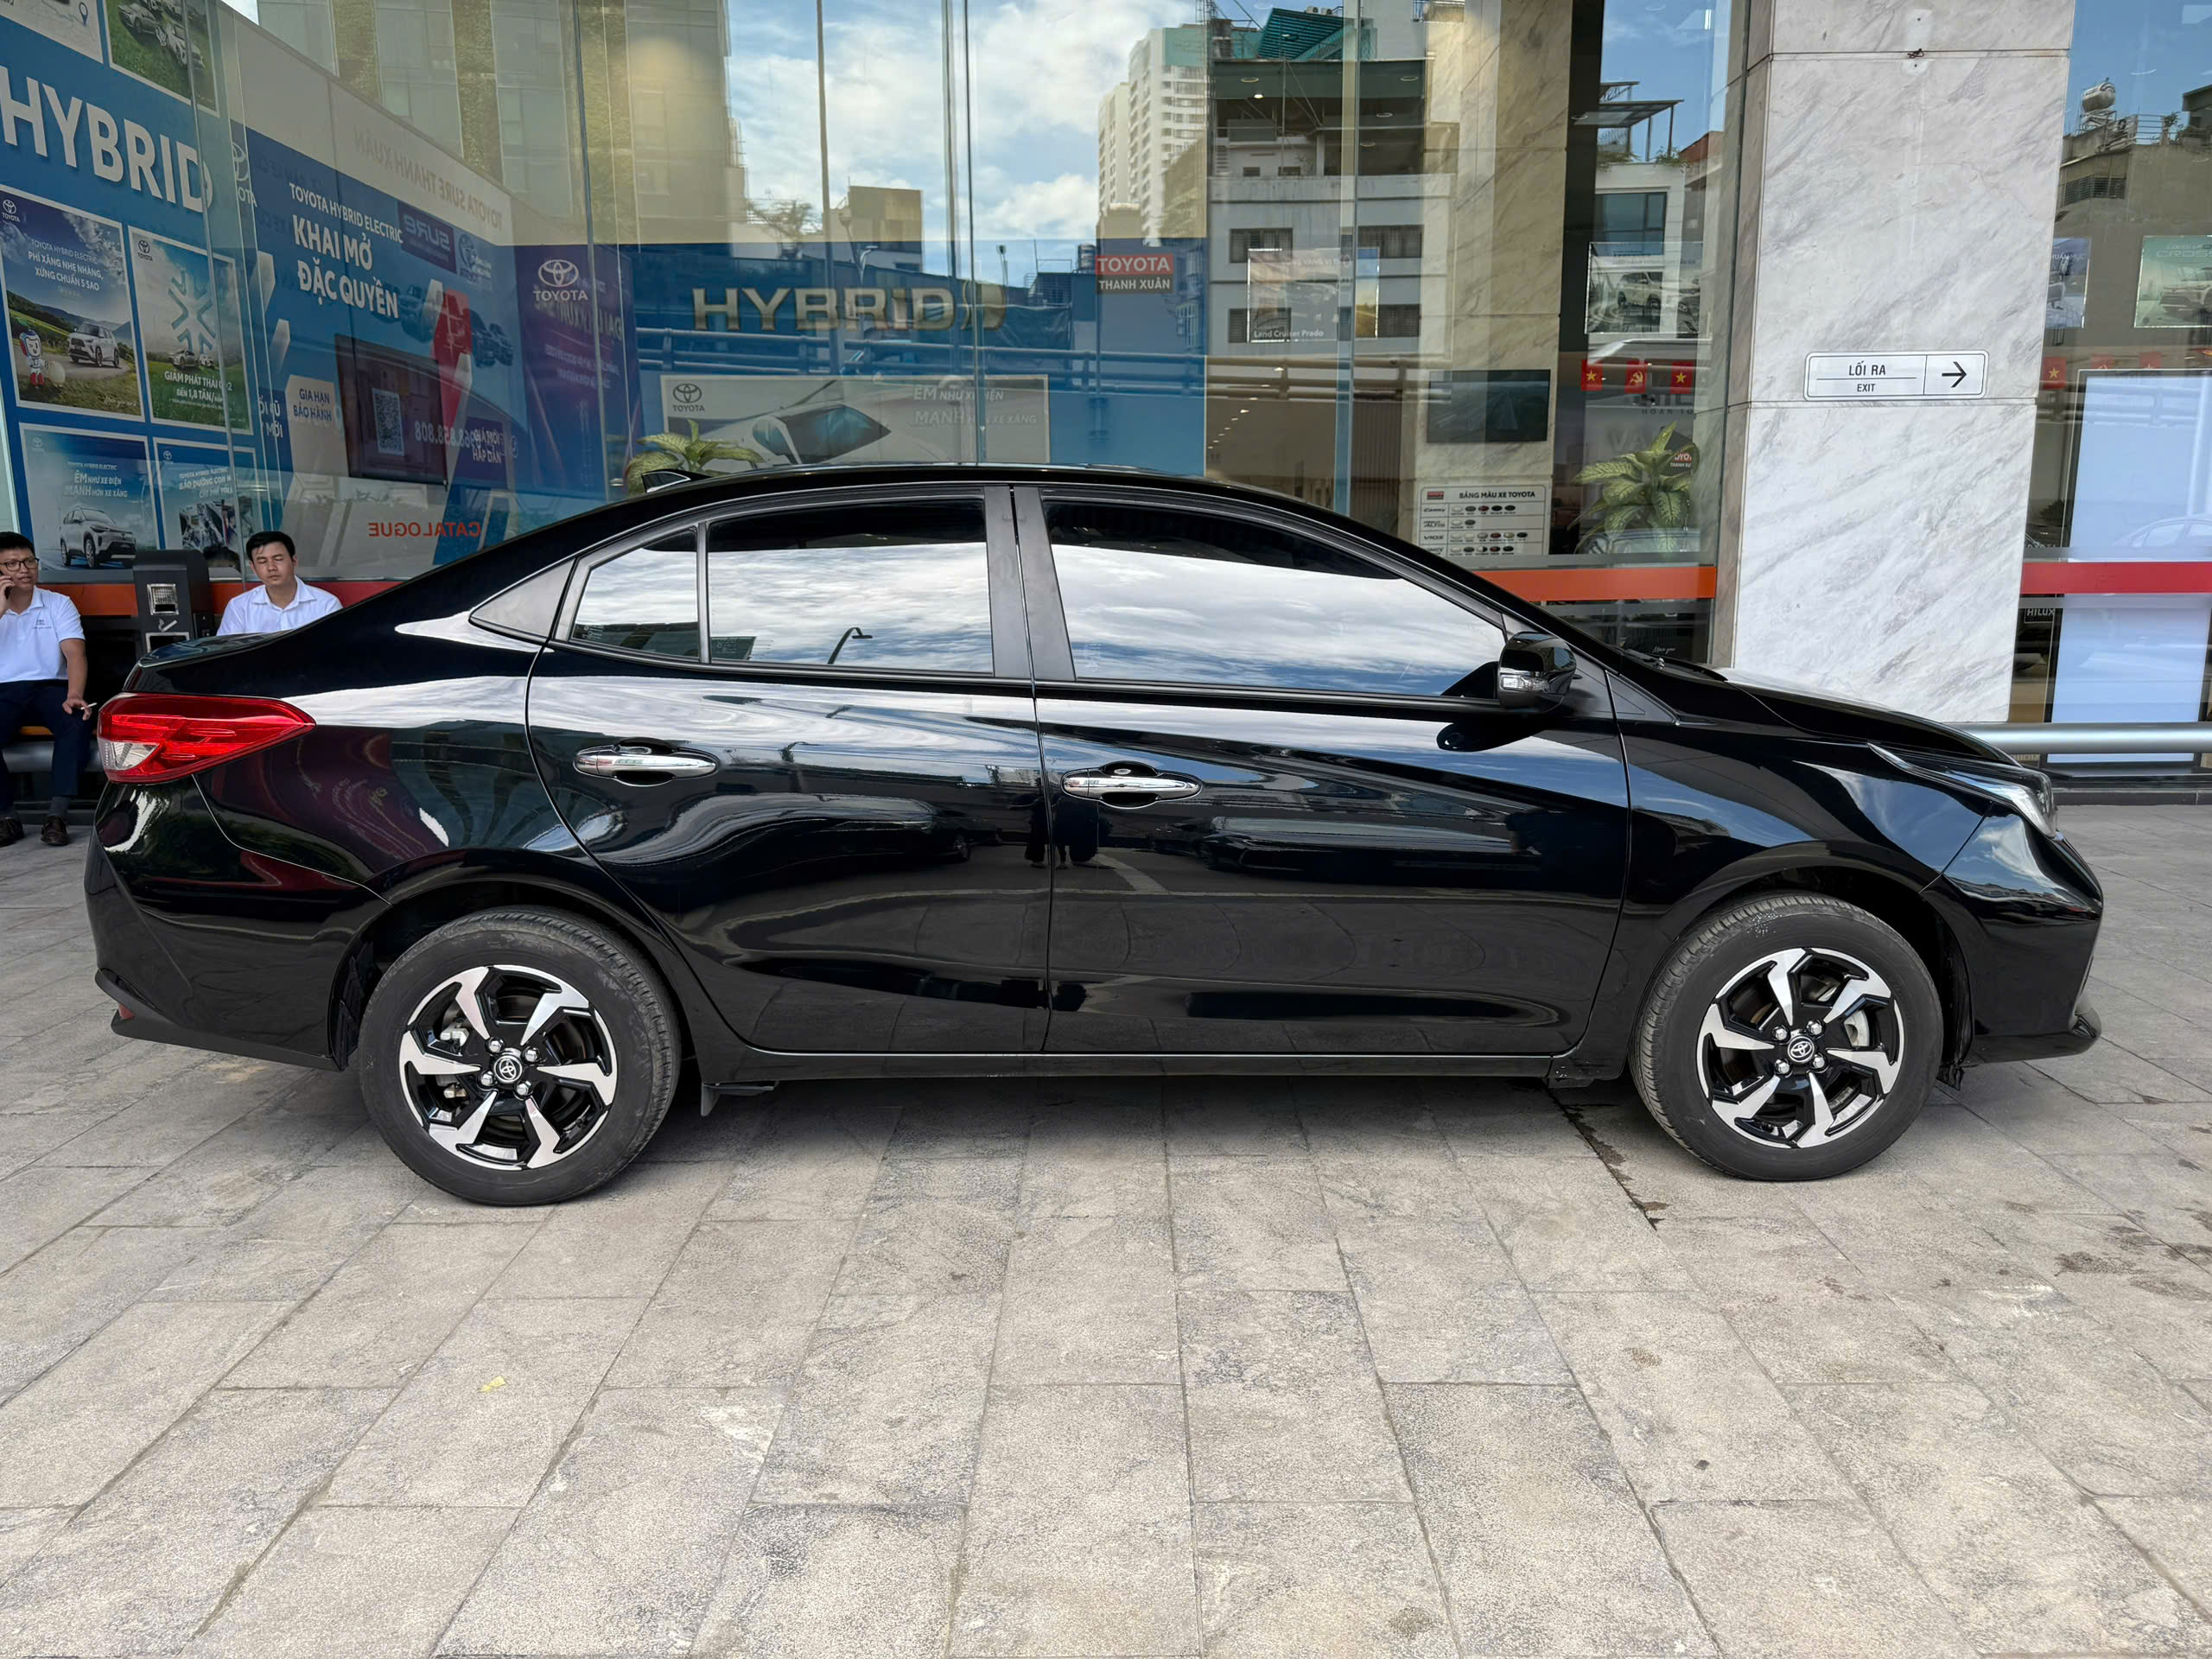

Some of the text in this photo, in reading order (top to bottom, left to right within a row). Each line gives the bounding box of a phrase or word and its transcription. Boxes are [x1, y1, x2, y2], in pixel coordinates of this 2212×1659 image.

[0, 65, 213, 213] HYBRID
[2, 213, 20, 223] TOYOTA
[289, 182, 403, 244] TOYOTA HYBRID ELECTRIC
[32, 238, 54, 251] TOYOTA
[293, 214, 341, 260] KHAI
[343, 232, 373, 270] MỞ
[1097, 257, 1170, 272] TOYOTA
[296, 256, 400, 319] ĐẶC QUYỀN
[1098, 276, 1170, 289] THANH XUÂN
[532, 289, 588, 302] TOYOTA
[692, 287, 956, 332] HYBRID
[1254, 328, 1325, 339] Land Cruiser Prado
[1848, 360, 1886, 376] LỐI RA
[299, 388, 314, 401] GIA
[1857, 384, 1876, 392] EXIT
[1480, 490, 1497, 499] MÀU
